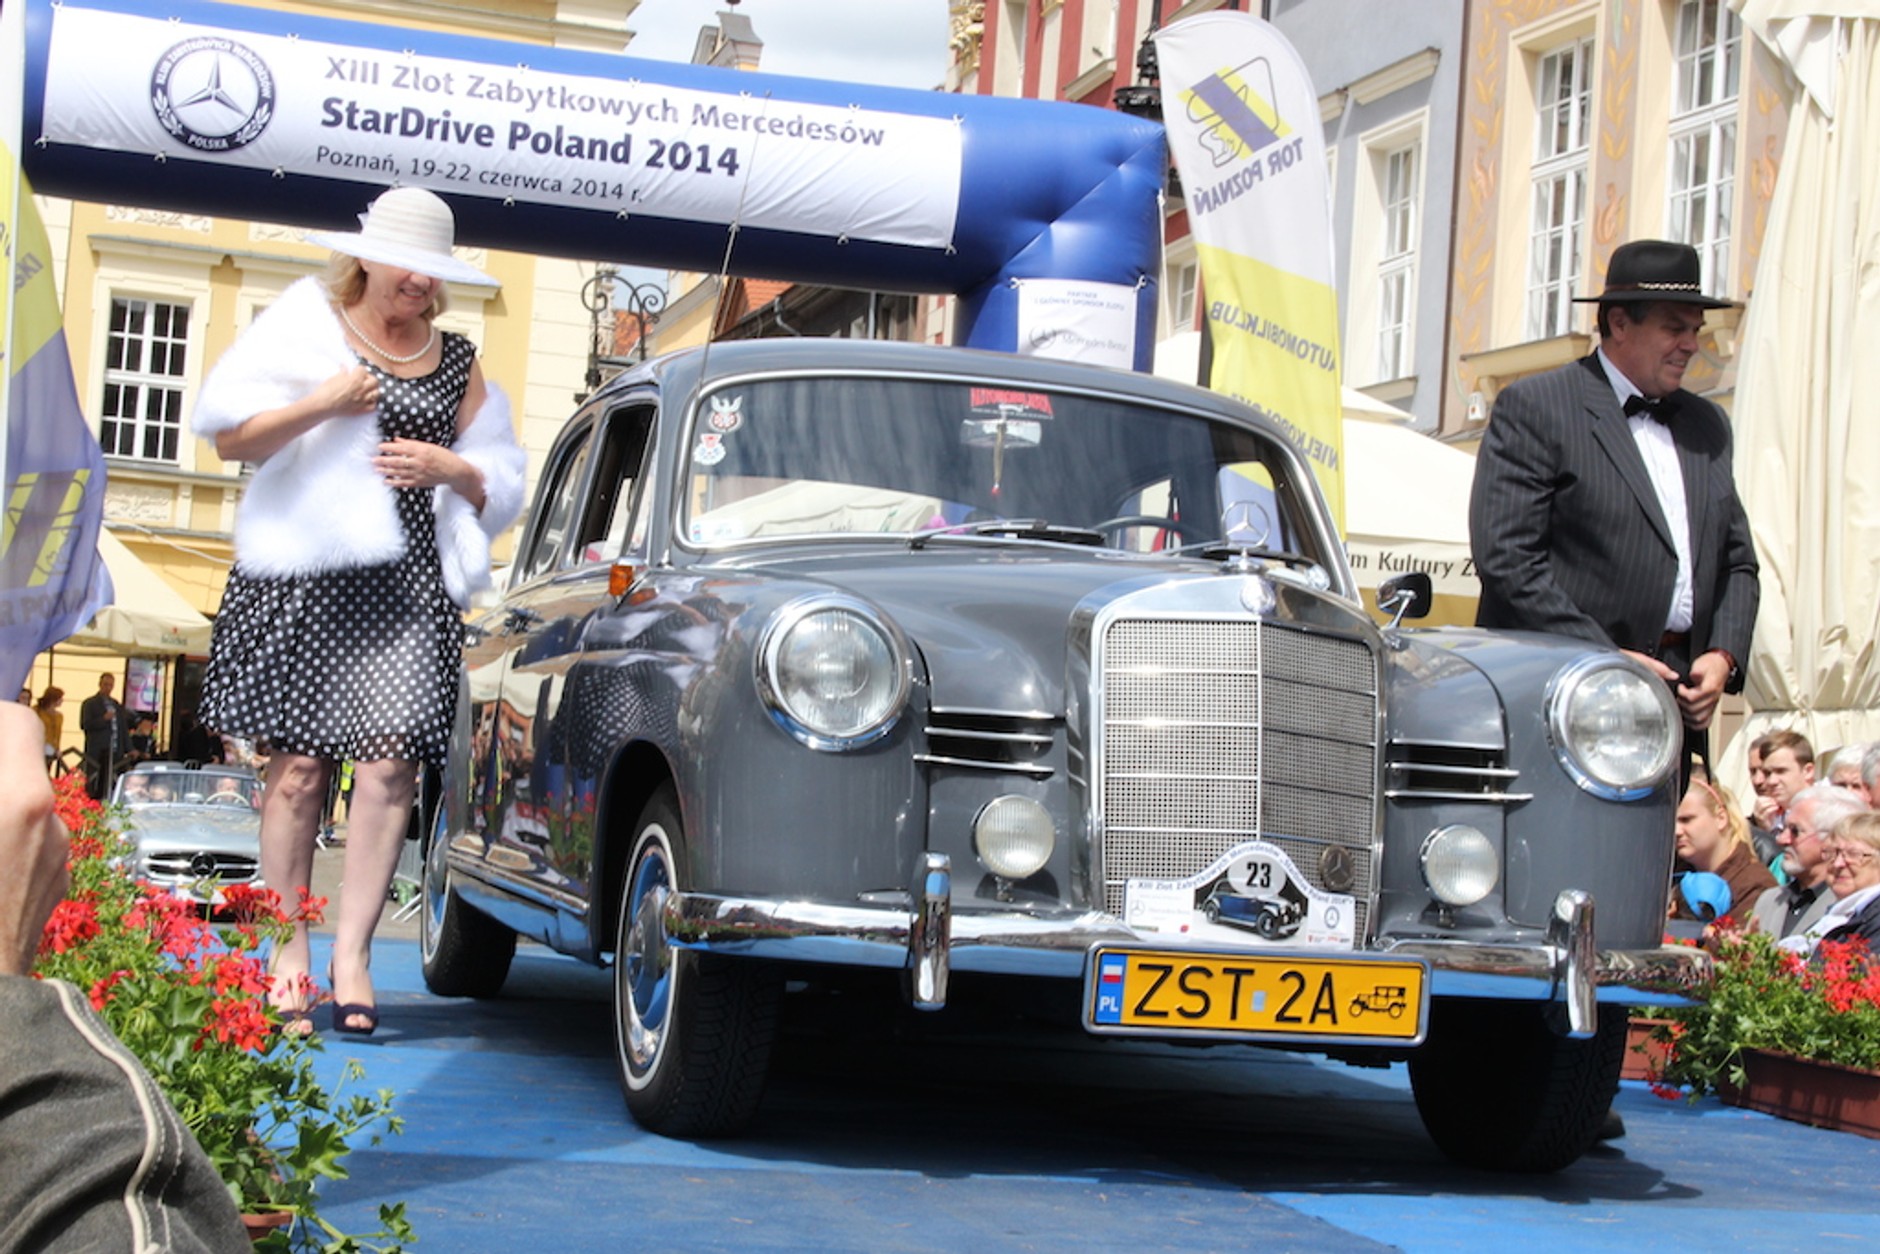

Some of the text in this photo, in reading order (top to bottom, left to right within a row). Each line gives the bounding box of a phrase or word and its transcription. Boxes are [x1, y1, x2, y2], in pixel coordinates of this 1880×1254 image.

[324, 56, 885, 147] XIII Zlot Zabytkowych Mercedesów
[187, 134, 229, 150] POLSKA
[320, 96, 740, 177] StarDrive Poland 2014
[316, 145, 643, 203] Poznań, 19-22 czerwca 2014 r.
[1378, 551, 1454, 579] Kultury
[1246, 862, 1272, 888] 23
[1099, 963, 1339, 1026] PL ZST 2A
